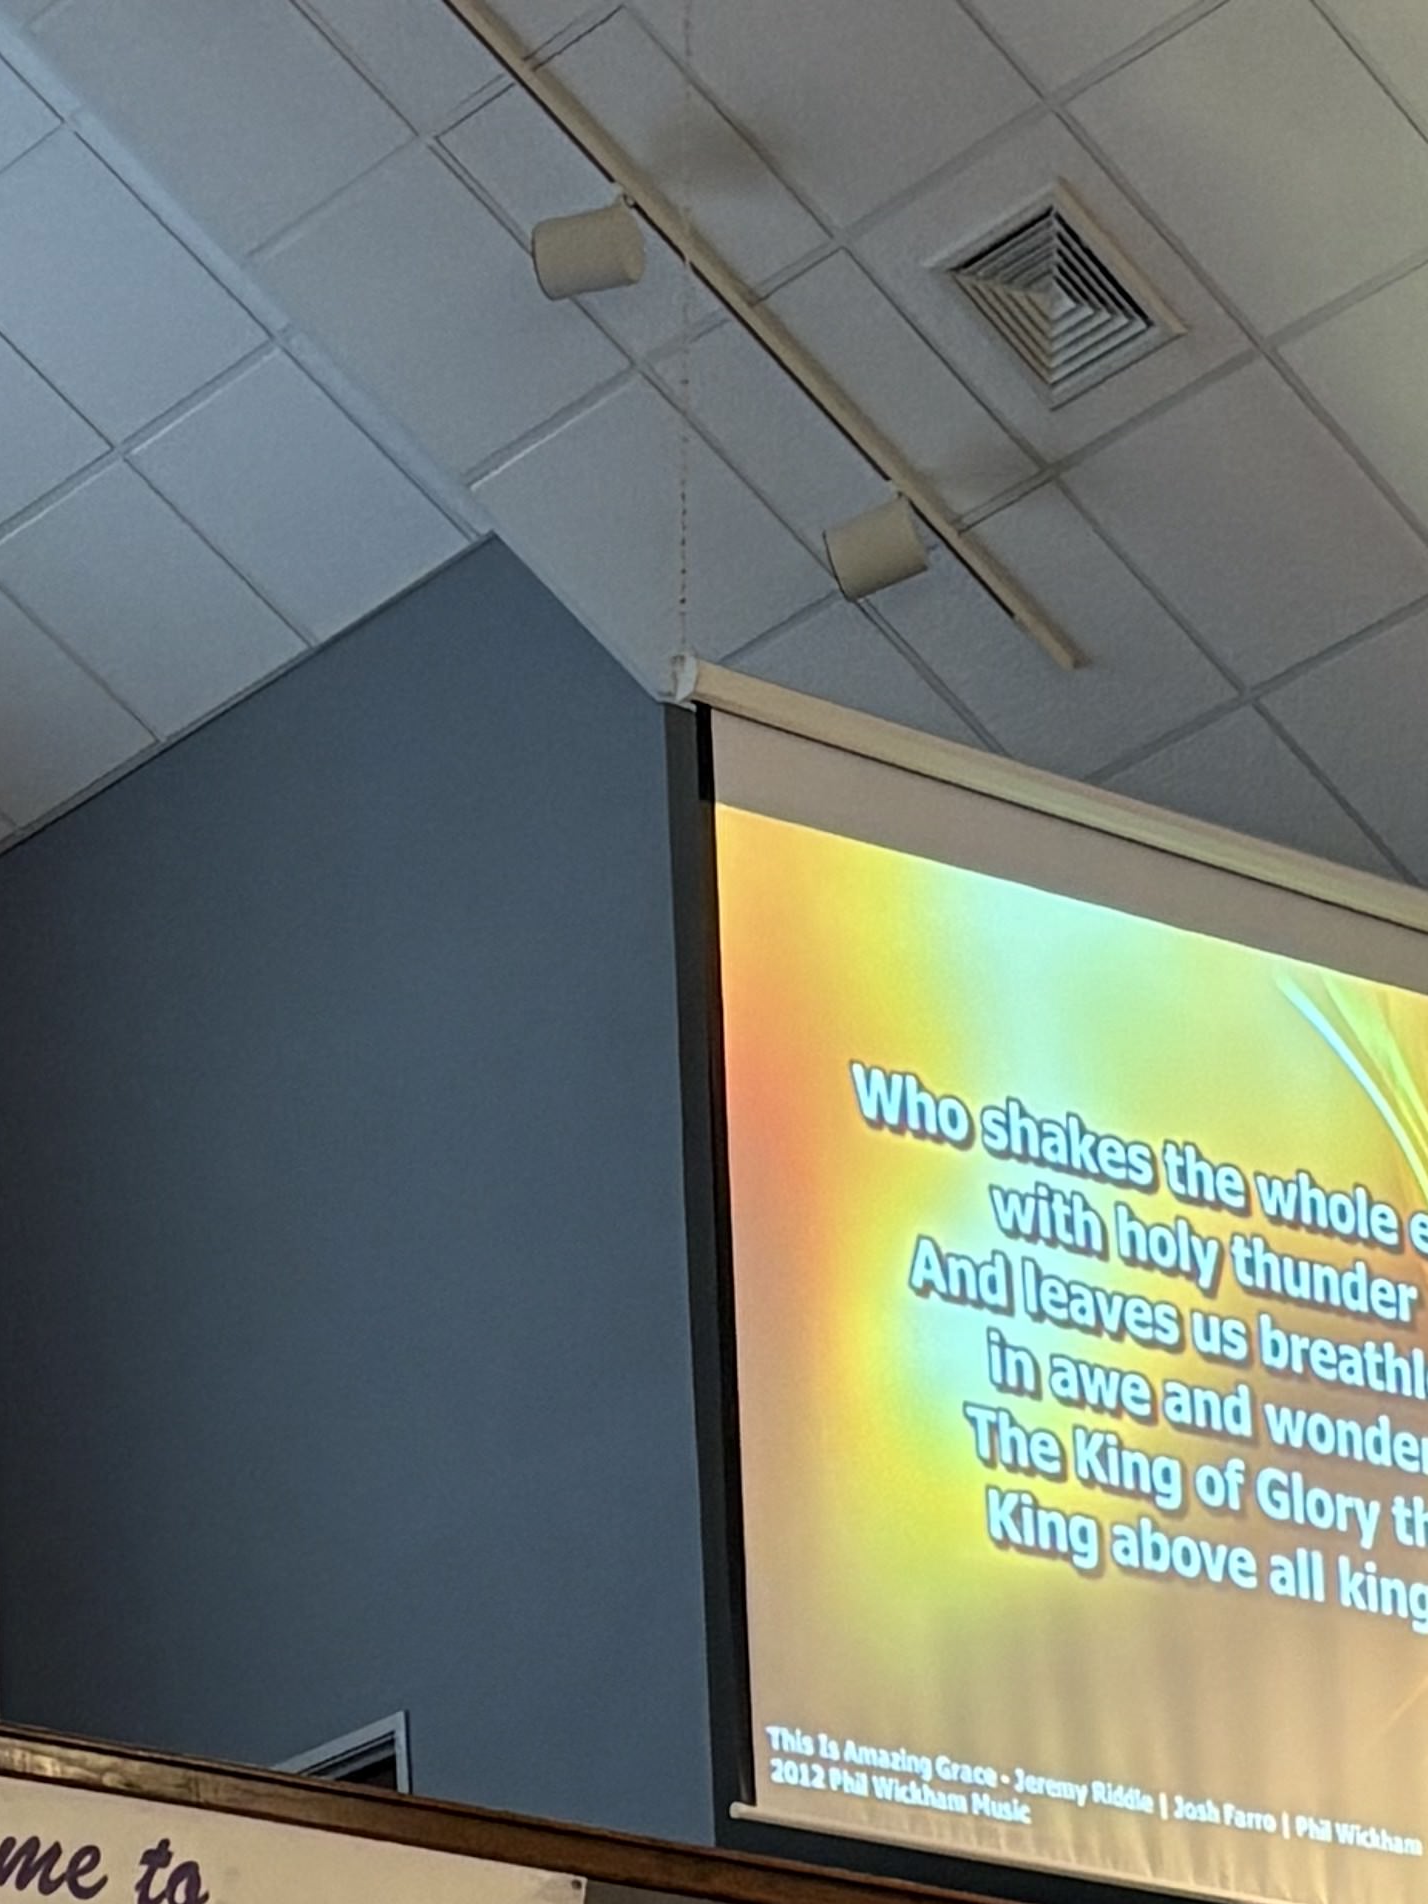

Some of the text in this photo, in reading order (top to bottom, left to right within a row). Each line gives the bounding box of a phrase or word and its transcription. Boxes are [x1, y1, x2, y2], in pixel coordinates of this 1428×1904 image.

[850, 1062, 968, 1142] Who
[982, 1098, 1152, 1183] shakes
[1164, 1142, 1245, 1206] the
[1256, 1171, 1399, 1244] whole
[910, 1237, 1006, 1307] And
[1021, 1256, 1178, 1343] leaves
[1192, 1310, 1246, 1358] us
[991, 1183, 1417, 1321] with holy thunder
[987, 1329, 1035, 1392] in
[1050, 1353, 1150, 1414] awe
[1164, 1377, 1251, 1436] and
[965, 1406, 1060, 1474] The
[1073, 1427, 1181, 1508] King
[1196, 1457, 1243, 1510] of
[1258, 1466, 1379, 1548] Glory
[986, 1486, 1097, 1570] King
[1112, 1516, 1256, 1589] above
[1269, 1547, 1323, 1602] all
[767, 1726, 813, 1756] This
[818, 1733, 840, 1761] Is
[844, 1740, 932, 1779] Amazing
[936, 1755, 997, 1787] Grace
[1014, 1768, 1087, 1807] Jeremy
[1091, 1780, 1154, 1814] Riddle
[1174, 1795, 1220, 1825] Josh
[1223, 1803, 1276, 1833] Farro
[1295, 1814, 1332, 1843] Phil
[1335, 1821, 1423, 1856] Wickham
[771, 1758, 1032, 1825] 2012 Phil Wickham Music
